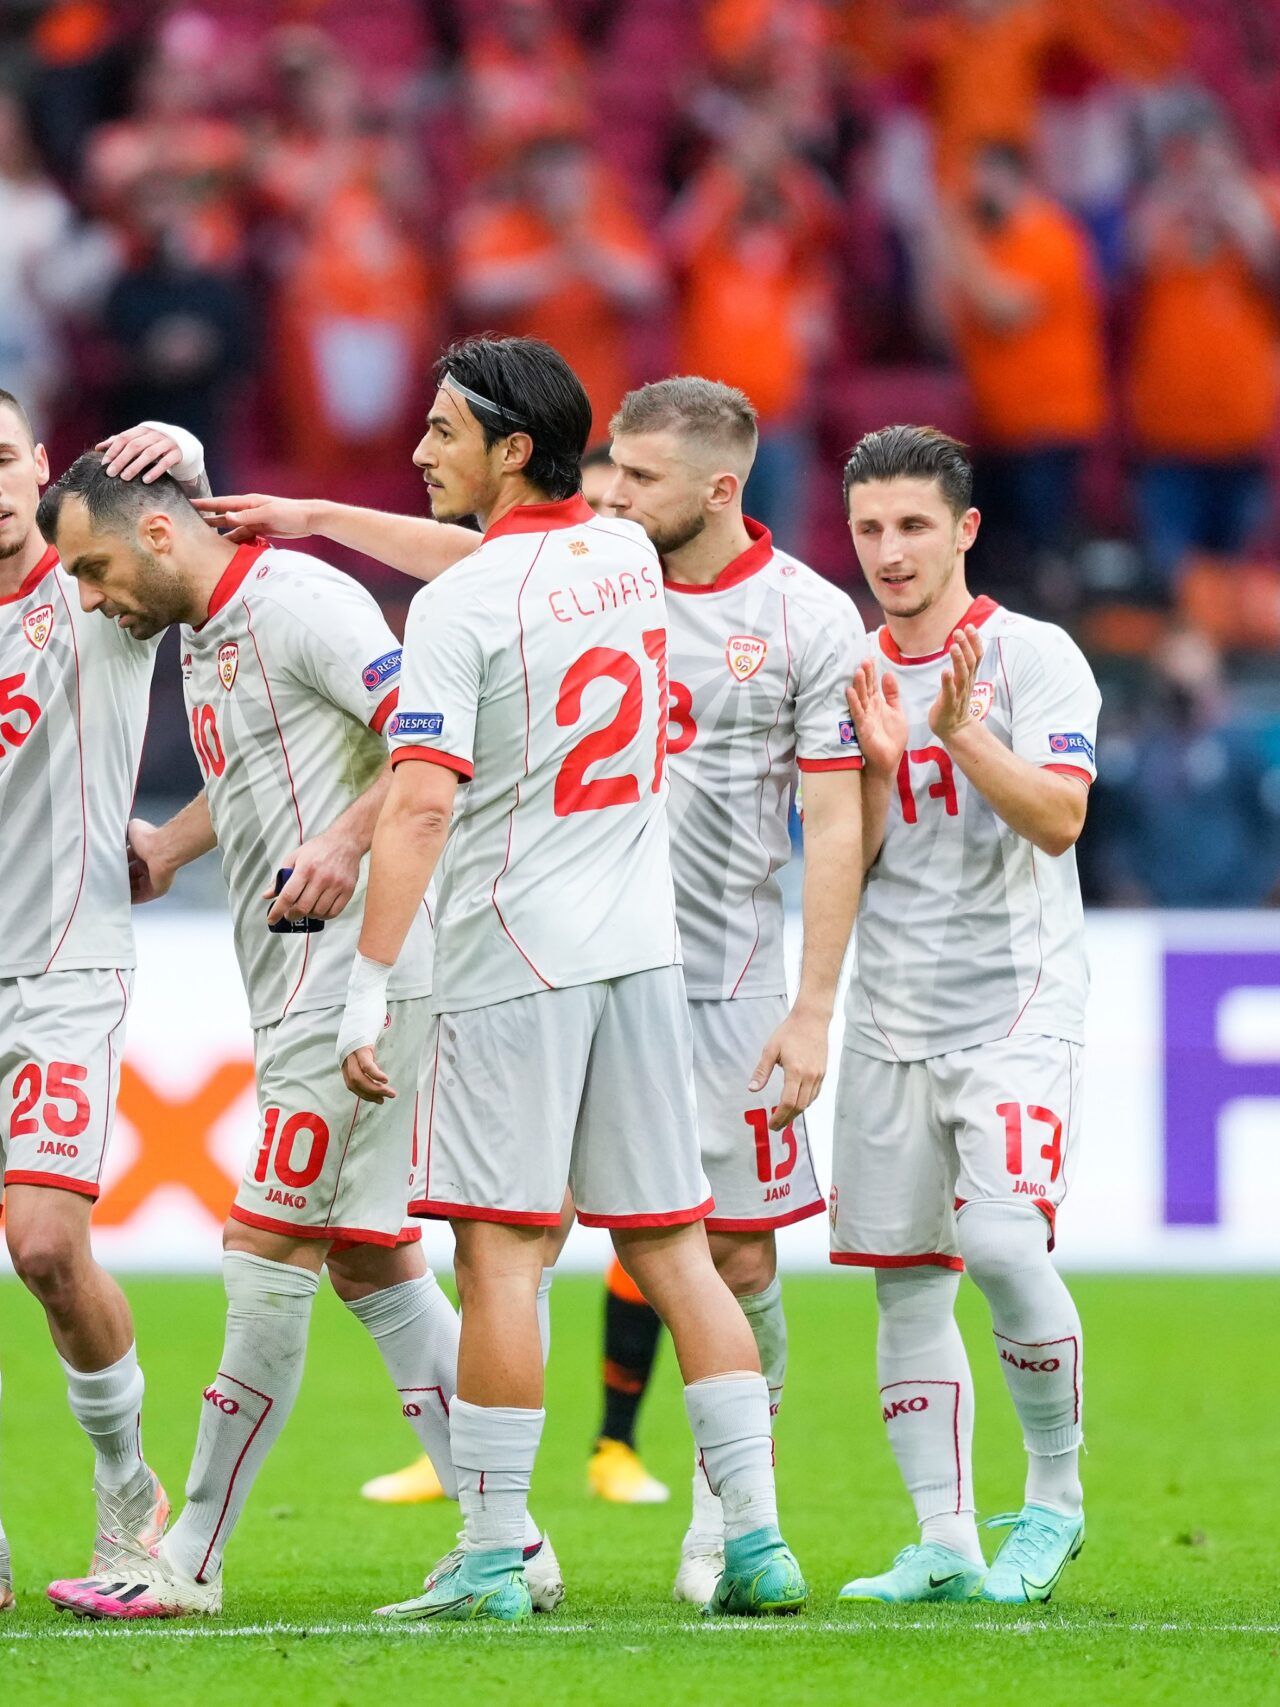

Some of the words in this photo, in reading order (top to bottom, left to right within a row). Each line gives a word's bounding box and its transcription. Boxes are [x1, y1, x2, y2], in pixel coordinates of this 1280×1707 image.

[548, 566, 658, 623] ELMAS
[192, 703, 226, 780] 10
[398, 718, 443, 730] RESPECT
[553, 628, 667, 817] 21
[896, 746, 959, 824] 17
[9, 1061, 91, 1140] 25
[36, 1140, 79, 1159] JAKO
[253, 1107, 330, 1189] 10
[744, 1105, 798, 1183] 13
[995, 1102, 1063, 1184] 17
[264, 1188, 307, 1210] JAKO
[763, 1182, 791, 1203] JAKO
[1012, 1180, 1047, 1198] JAKO
[1000, 1349, 1060, 1373] JAKO
